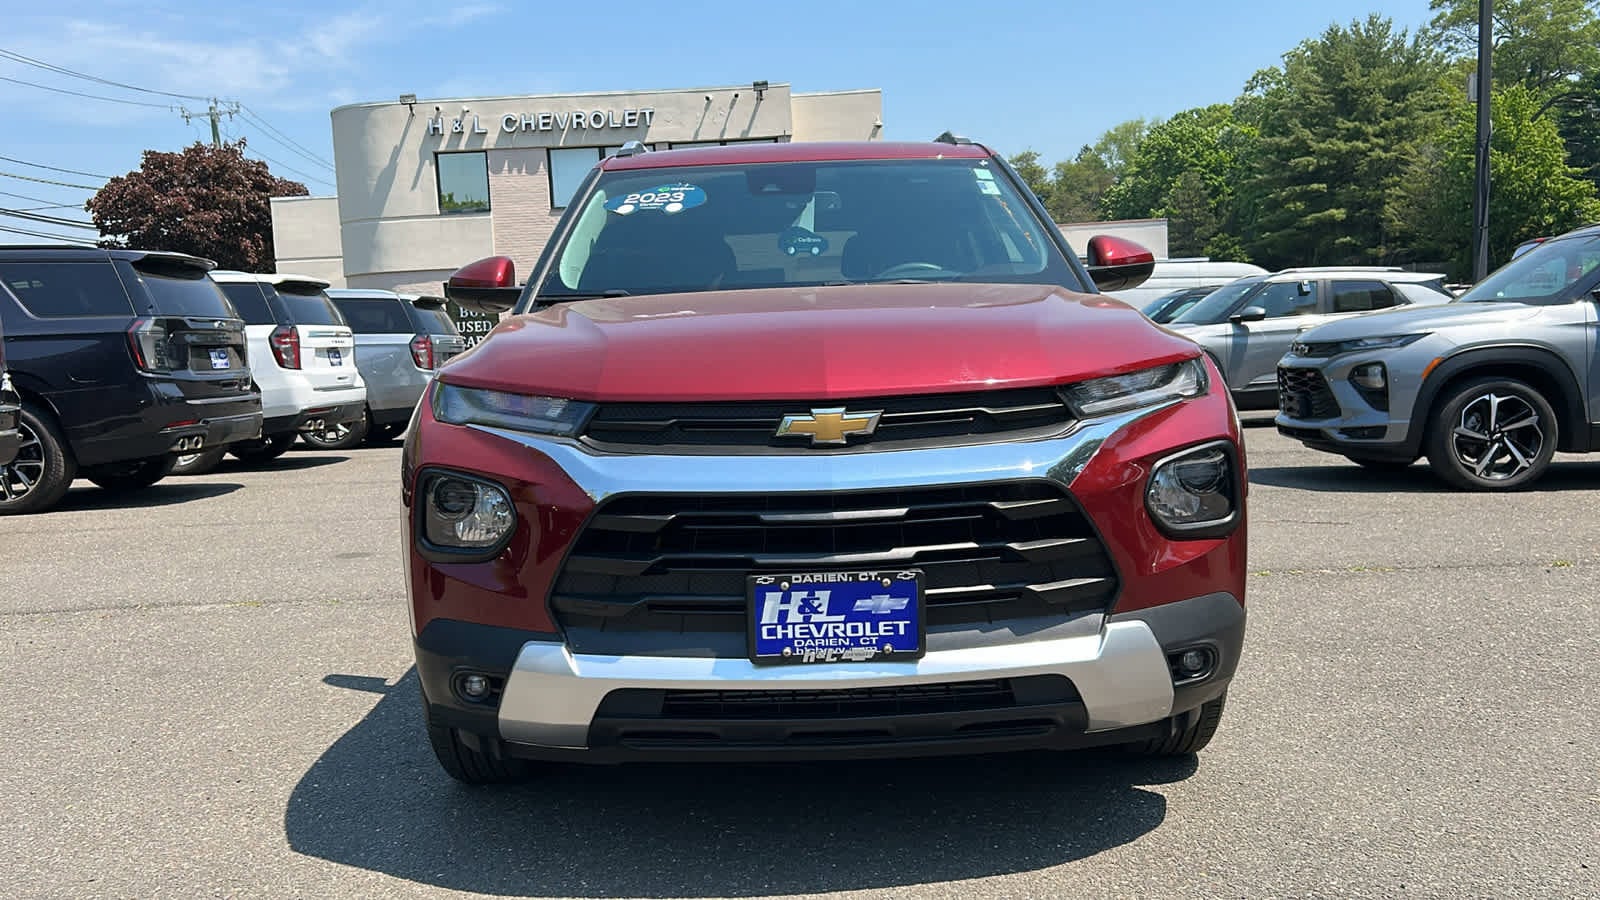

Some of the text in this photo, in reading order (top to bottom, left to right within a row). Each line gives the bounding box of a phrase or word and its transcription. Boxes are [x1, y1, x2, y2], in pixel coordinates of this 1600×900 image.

[428, 108, 655, 135] H & L CHEVROLET
[623, 191, 686, 204] 2023
[459, 306, 486, 318] BU
[456, 320, 492, 333] USED
[791, 572, 881, 584] DARIEN, CT.
[760, 590, 847, 624] H&L
[761, 621, 911, 640] CHEVROLET
[860, 636, 879, 646] CT
